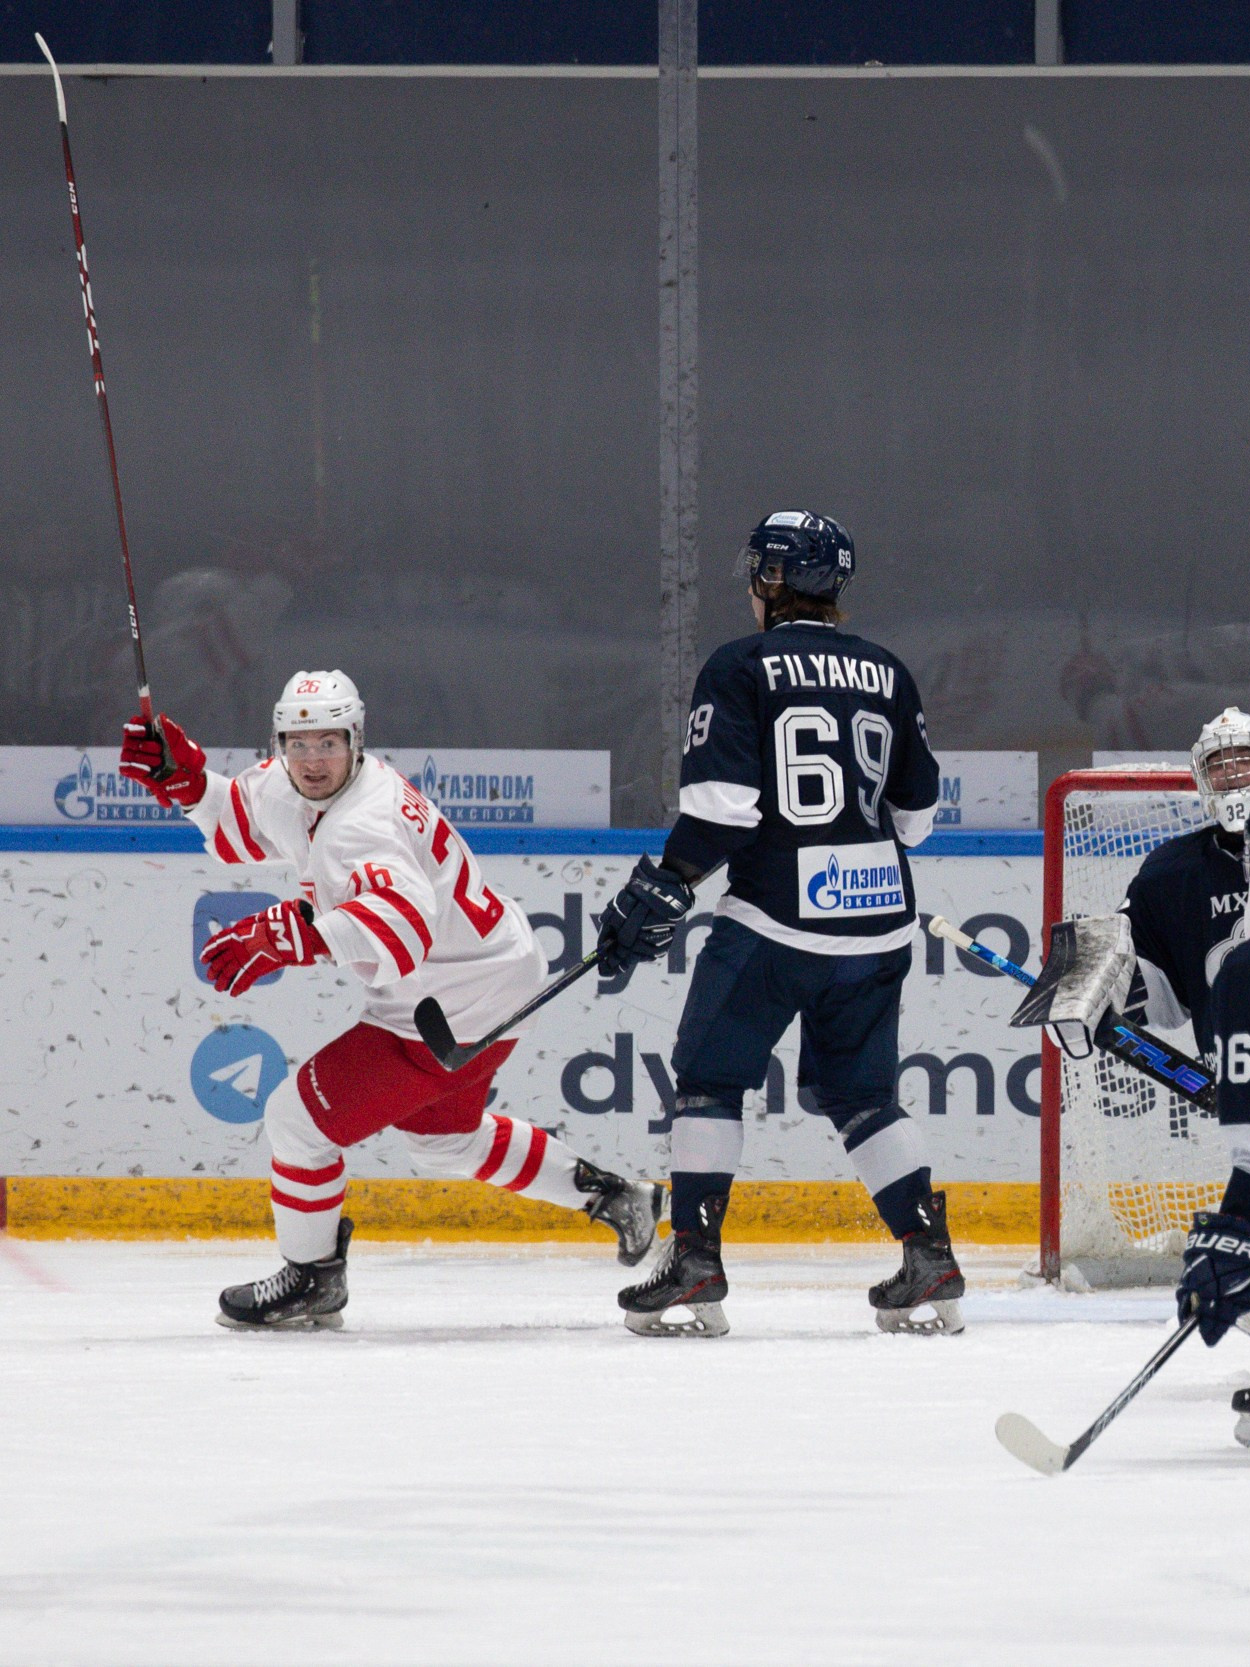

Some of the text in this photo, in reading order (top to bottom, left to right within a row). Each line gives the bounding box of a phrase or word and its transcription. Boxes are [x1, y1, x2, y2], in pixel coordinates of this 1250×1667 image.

[766, 542, 789, 551] CCM
[838, 548, 851, 568] 69
[128, 604, 139, 640] CCM
[296, 679, 321, 694] 26
[762, 654, 894, 699] FILYAKOV
[774, 706, 893, 829] 69
[441, 775, 533, 799] ГАЗПРОМ
[1226, 803, 1245, 822] 32
[842, 864, 901, 890] ГАЗПРОМ
[1113, 1025, 1210, 1094] TRUE
